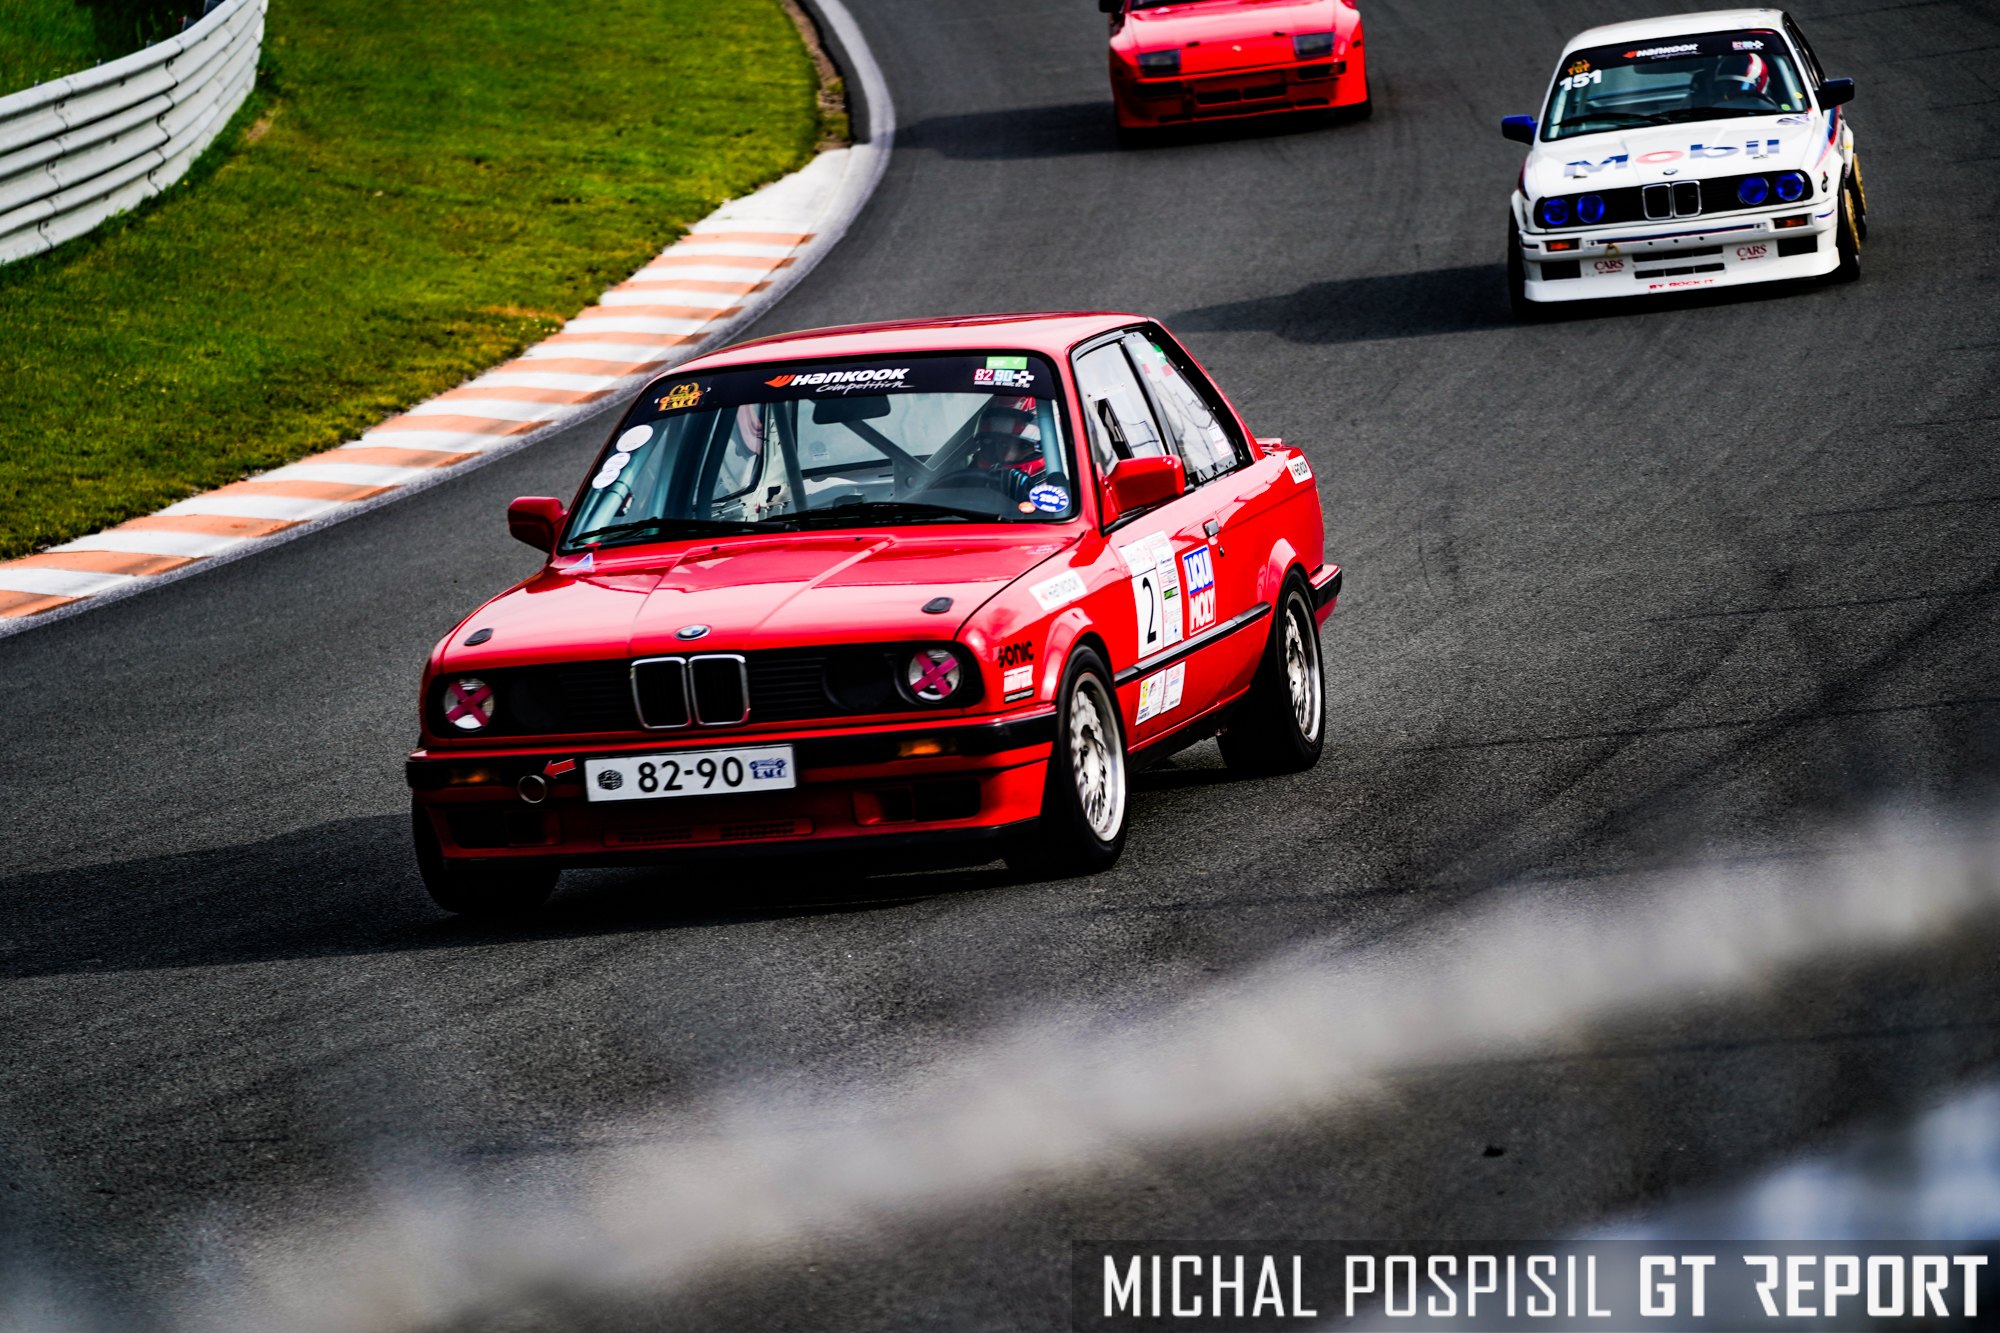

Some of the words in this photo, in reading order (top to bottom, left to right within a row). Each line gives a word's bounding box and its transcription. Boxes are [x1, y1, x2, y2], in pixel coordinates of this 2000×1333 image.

[1559, 69, 1602, 92] 151
[1564, 139, 1780, 177] Mobil
[1594, 259, 1624, 271] CARS
[1736, 245, 1767, 258] CARS
[974, 368, 994, 381] 82
[994, 369, 1014, 382] 90
[1184, 549, 1214, 592] LIQUI
[1142, 576, 1157, 645] 2
[1190, 588, 1215, 631] MOLY
[638, 756, 744, 793] 82-90
